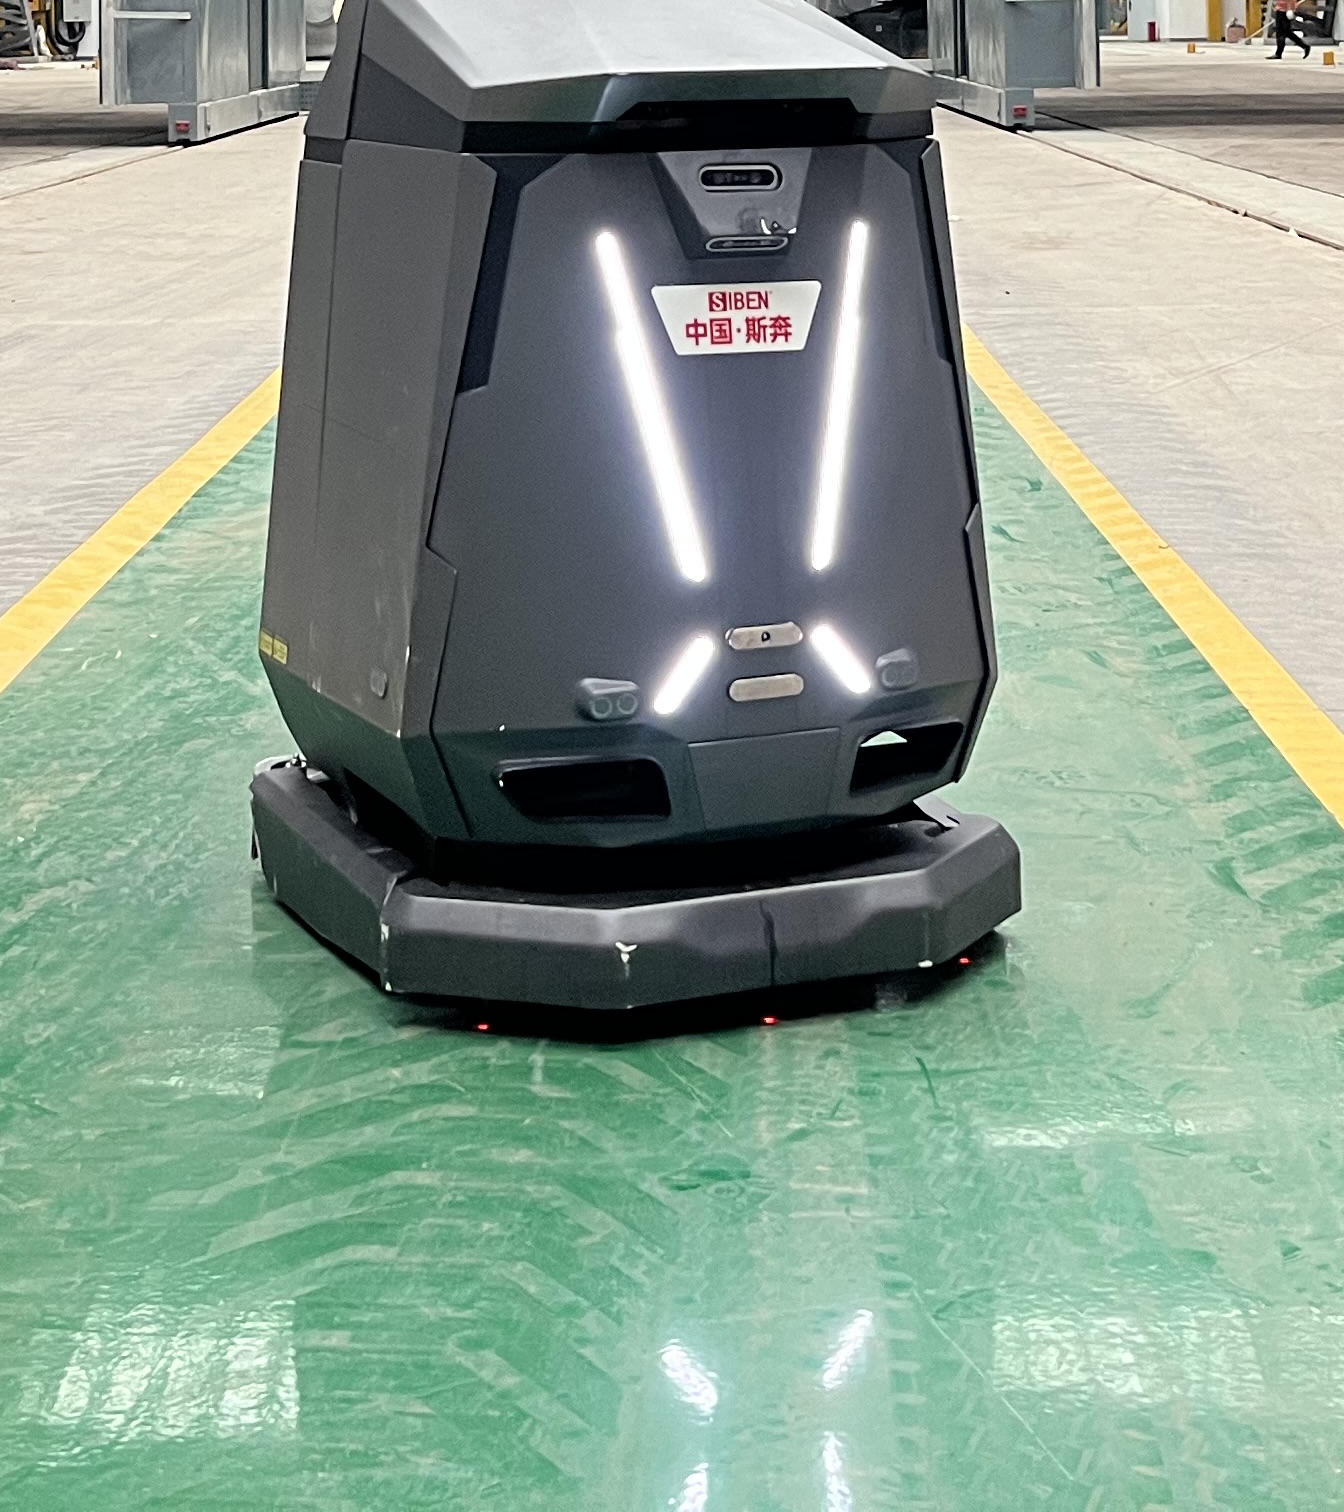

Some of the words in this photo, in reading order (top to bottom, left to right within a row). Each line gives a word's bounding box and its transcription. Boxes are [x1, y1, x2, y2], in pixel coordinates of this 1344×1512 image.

[708, 291, 769, 312] SIBEN
[685, 315, 793, 346] 中国·斯奔
